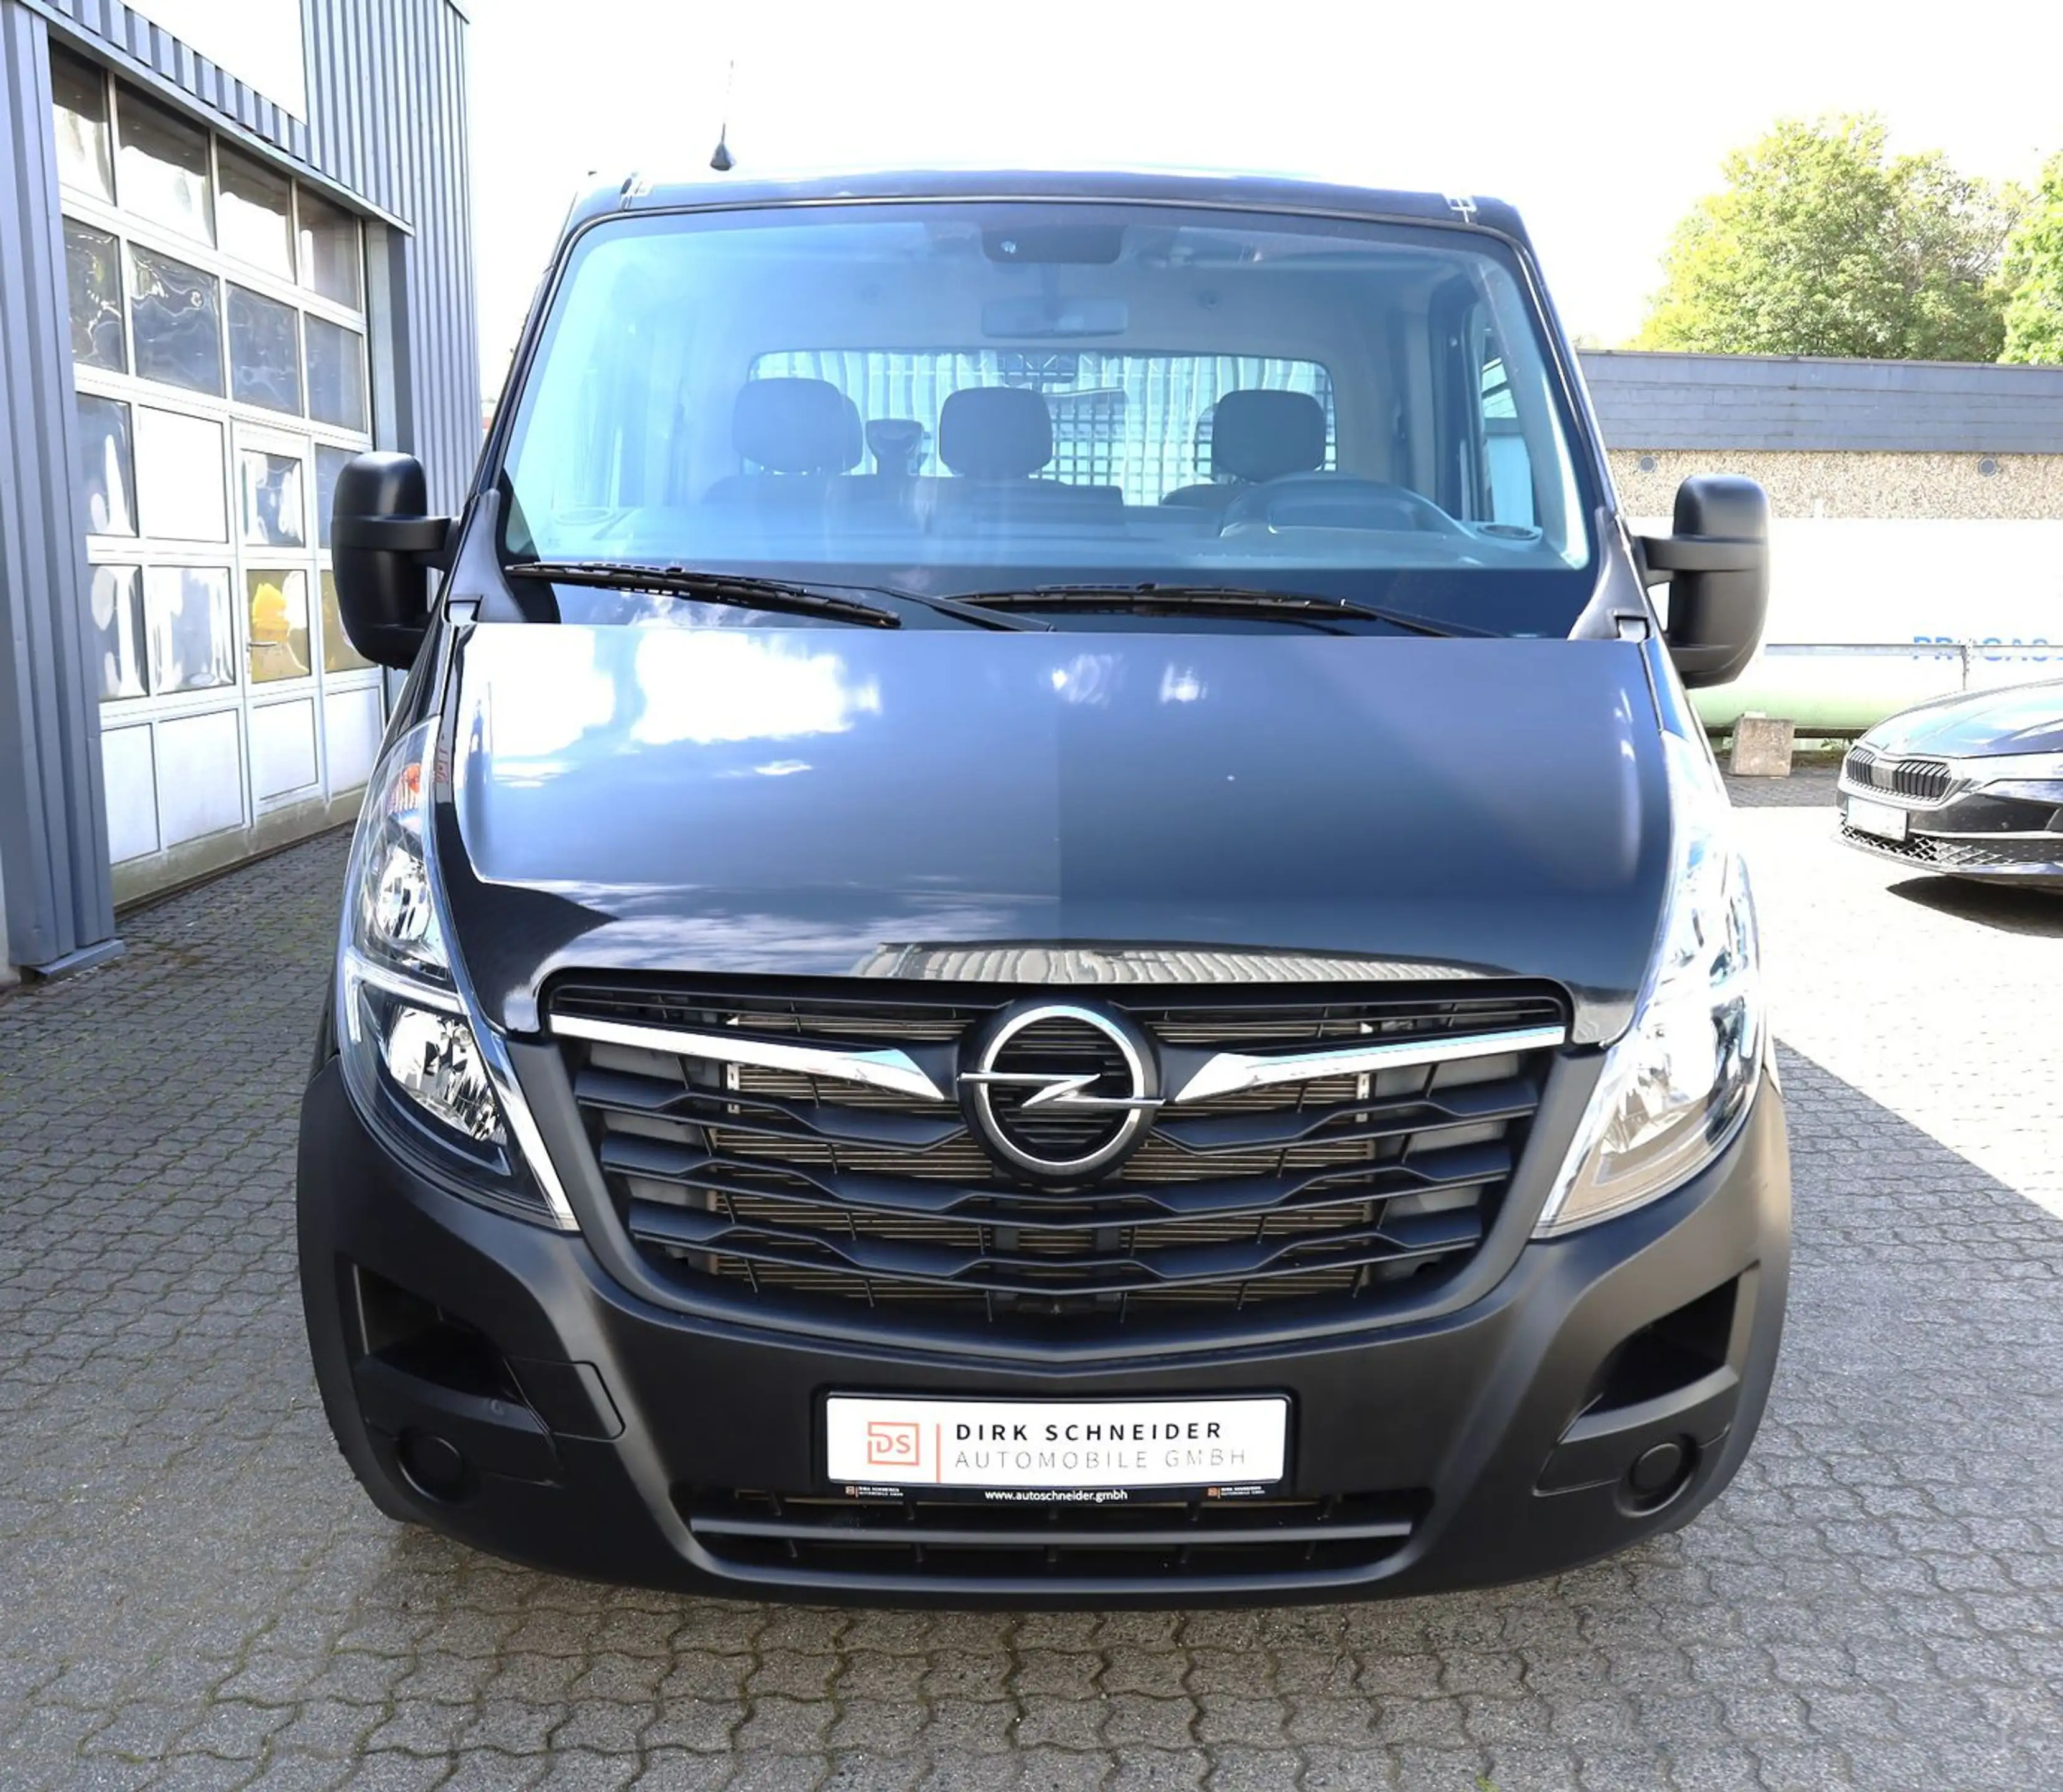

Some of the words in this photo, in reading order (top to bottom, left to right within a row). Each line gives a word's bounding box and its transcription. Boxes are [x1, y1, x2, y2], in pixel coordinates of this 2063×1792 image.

[956, 1424, 1028, 1441] DIRK
[1045, 1422, 1221, 1441] SCHNEIDER
[873, 1433, 911, 1454] DS
[955, 1450, 1147, 1470] AUTOMOBILE
[1165, 1448, 1245, 1468] GMBH
[985, 1490, 1129, 1503] www.autoschneider.gmbh
